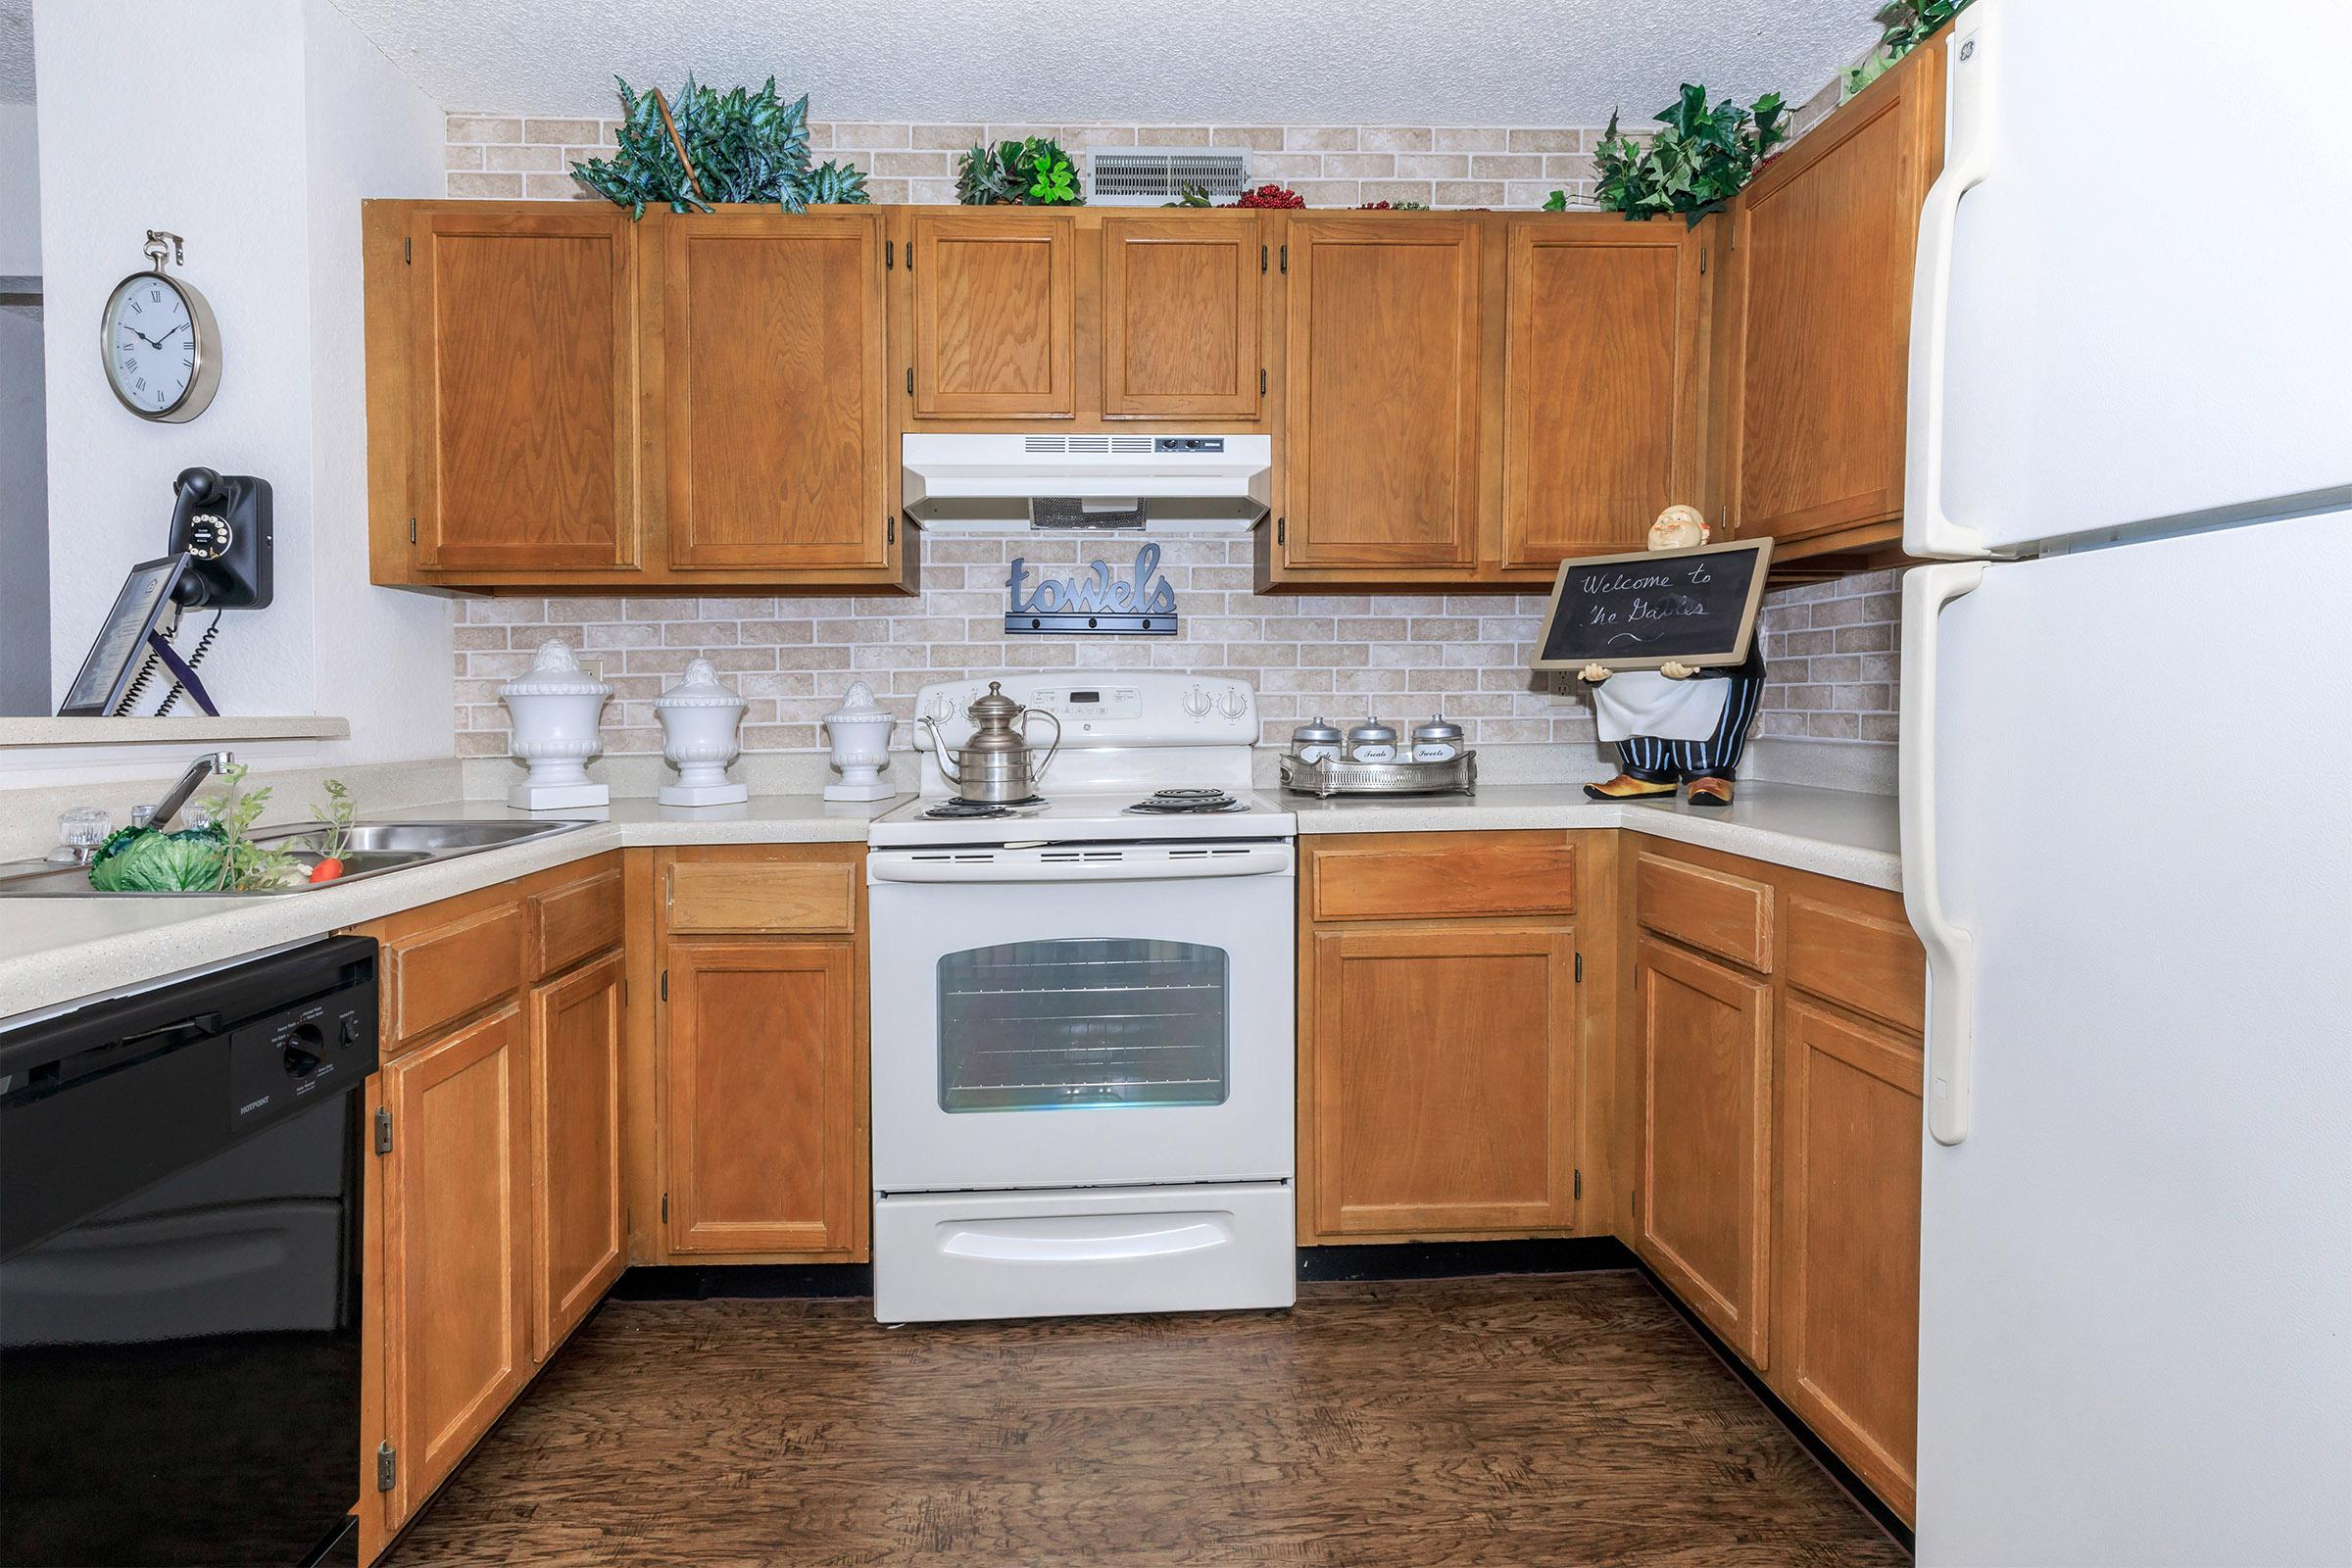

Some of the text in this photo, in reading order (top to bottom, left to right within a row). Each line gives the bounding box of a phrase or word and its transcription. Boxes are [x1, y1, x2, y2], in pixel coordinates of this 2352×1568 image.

[150, 290, 162, 304] XII
[1005, 543, 1177, 613] towels
[1580, 563, 1712, 595] Welcome to
[240, 1095, 270, 1116] HOTPOINT
